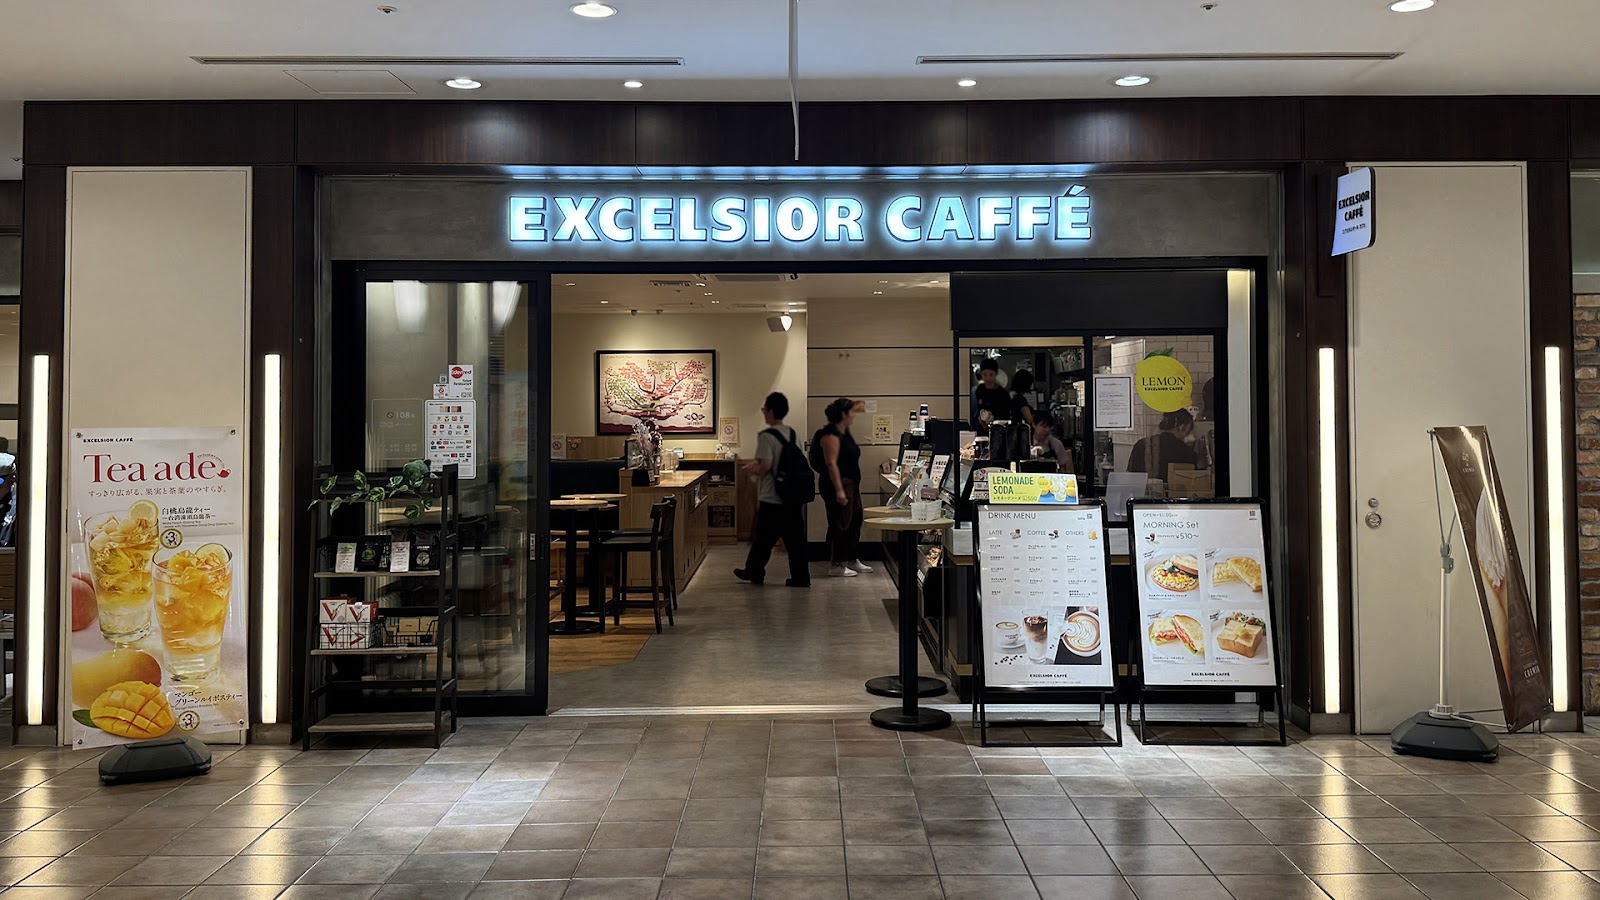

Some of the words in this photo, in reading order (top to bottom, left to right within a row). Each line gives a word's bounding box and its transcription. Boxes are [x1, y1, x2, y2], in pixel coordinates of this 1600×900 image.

[1338, 190, 1370, 210] EXCELSIOR
[509, 196, 865, 243] EXCELSIOR
[885, 184, 1092, 243] CAFFÉ
[1142, 376, 1186, 386] LEMON
[83, 454, 148, 483] Tea
[154, 452, 217, 482] ade
[992, 476, 1034, 485] LEMONADE
[993, 485, 1014, 495] SODA
[1143, 521, 1185, 529] MORNING
[1186, 521, 1199, 529] Set
[174, 690, 202, 698] マンゴー
[174, 693, 243, 706] グリーンルイボスティー
